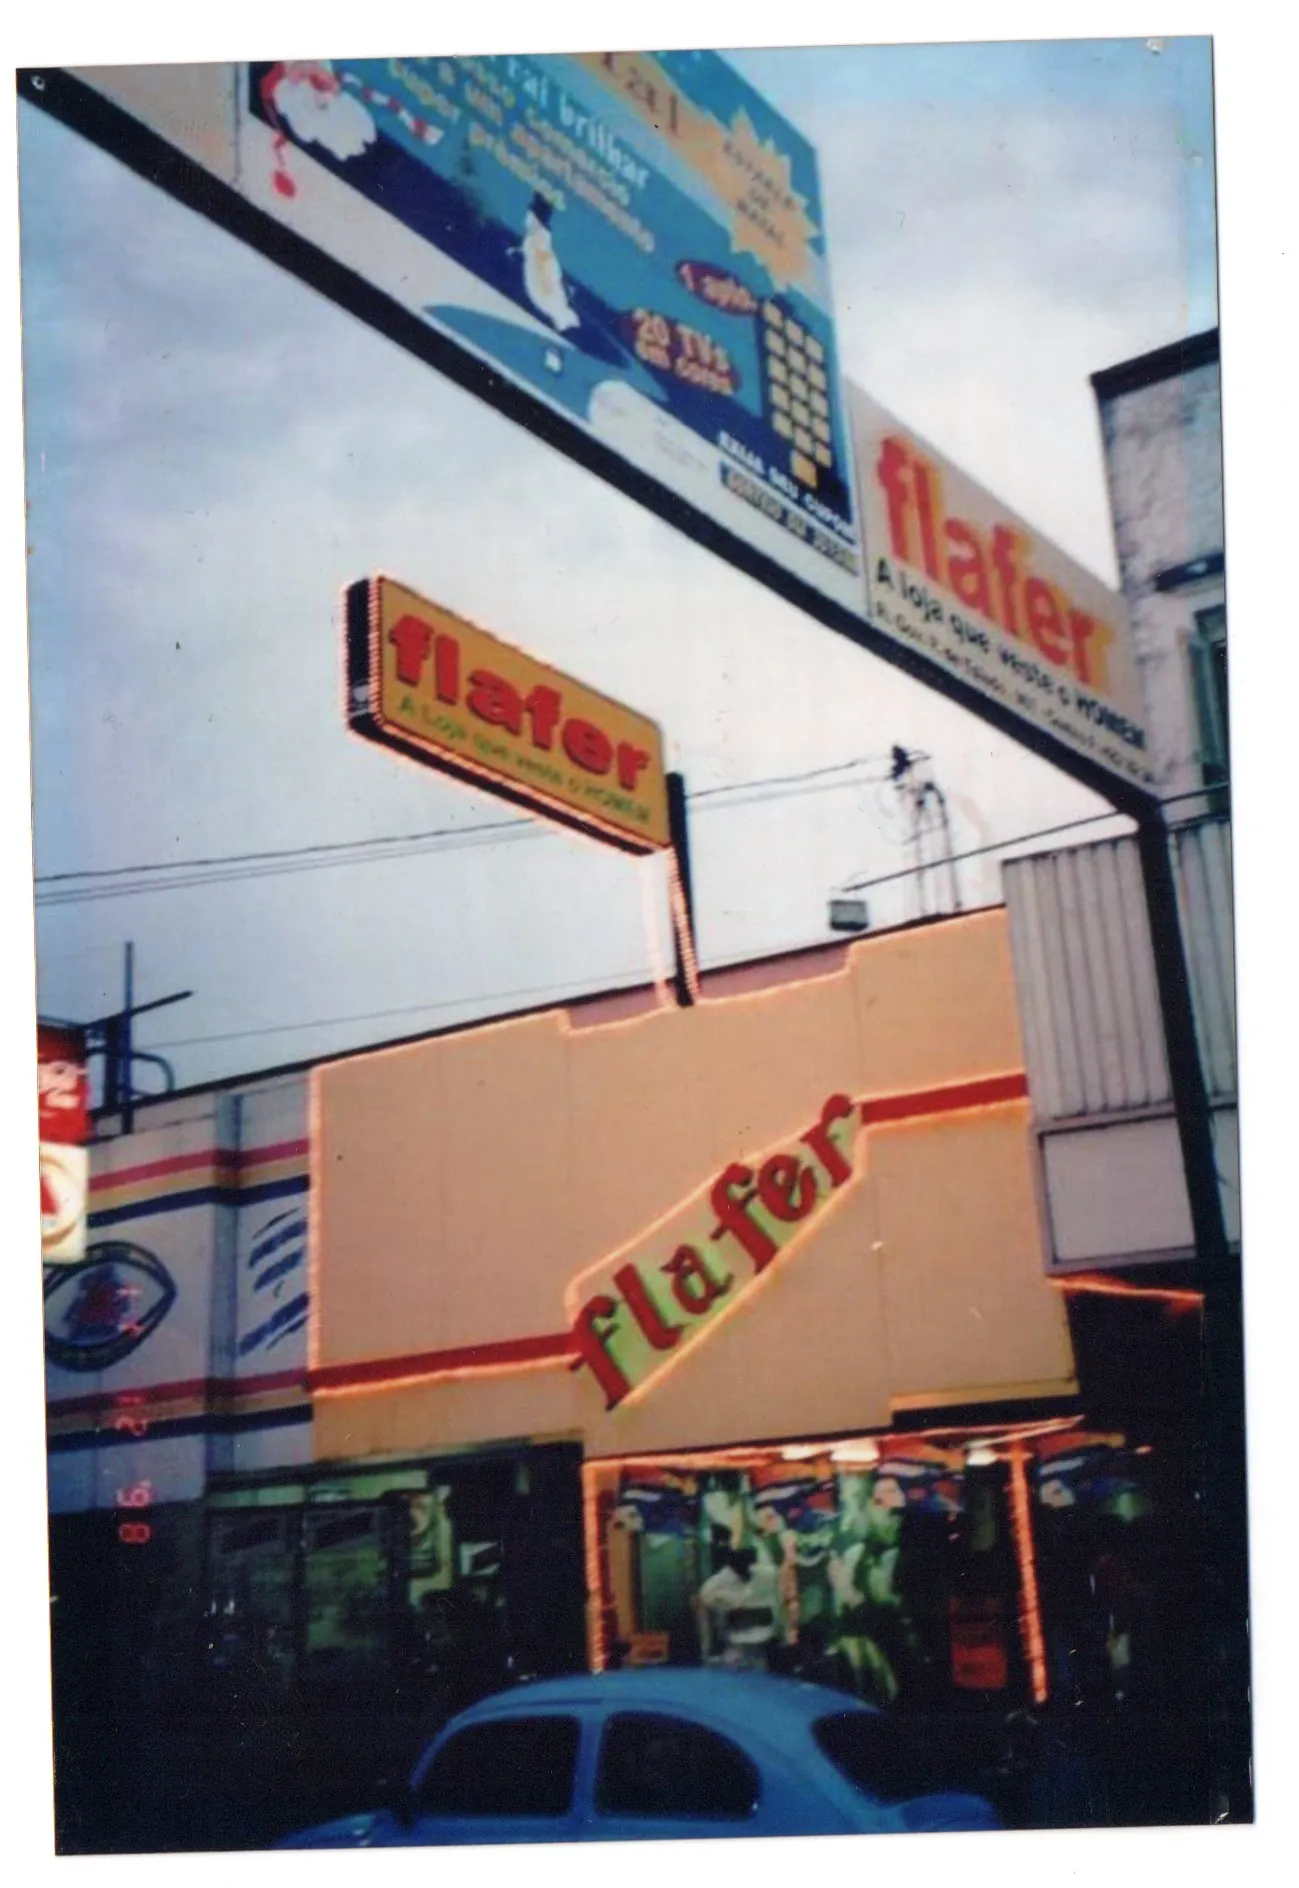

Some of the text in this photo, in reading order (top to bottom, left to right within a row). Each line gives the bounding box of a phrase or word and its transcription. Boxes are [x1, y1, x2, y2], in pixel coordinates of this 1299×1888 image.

[632, 307, 671, 348] 20
[877, 434, 1110, 690] flafer
[877, 557, 894, 591] A
[949, 612, 991, 655] que
[388, 614, 652, 792] flafer
[398, 694, 417, 719] A
[568, 1093, 855, 1412] flafer
